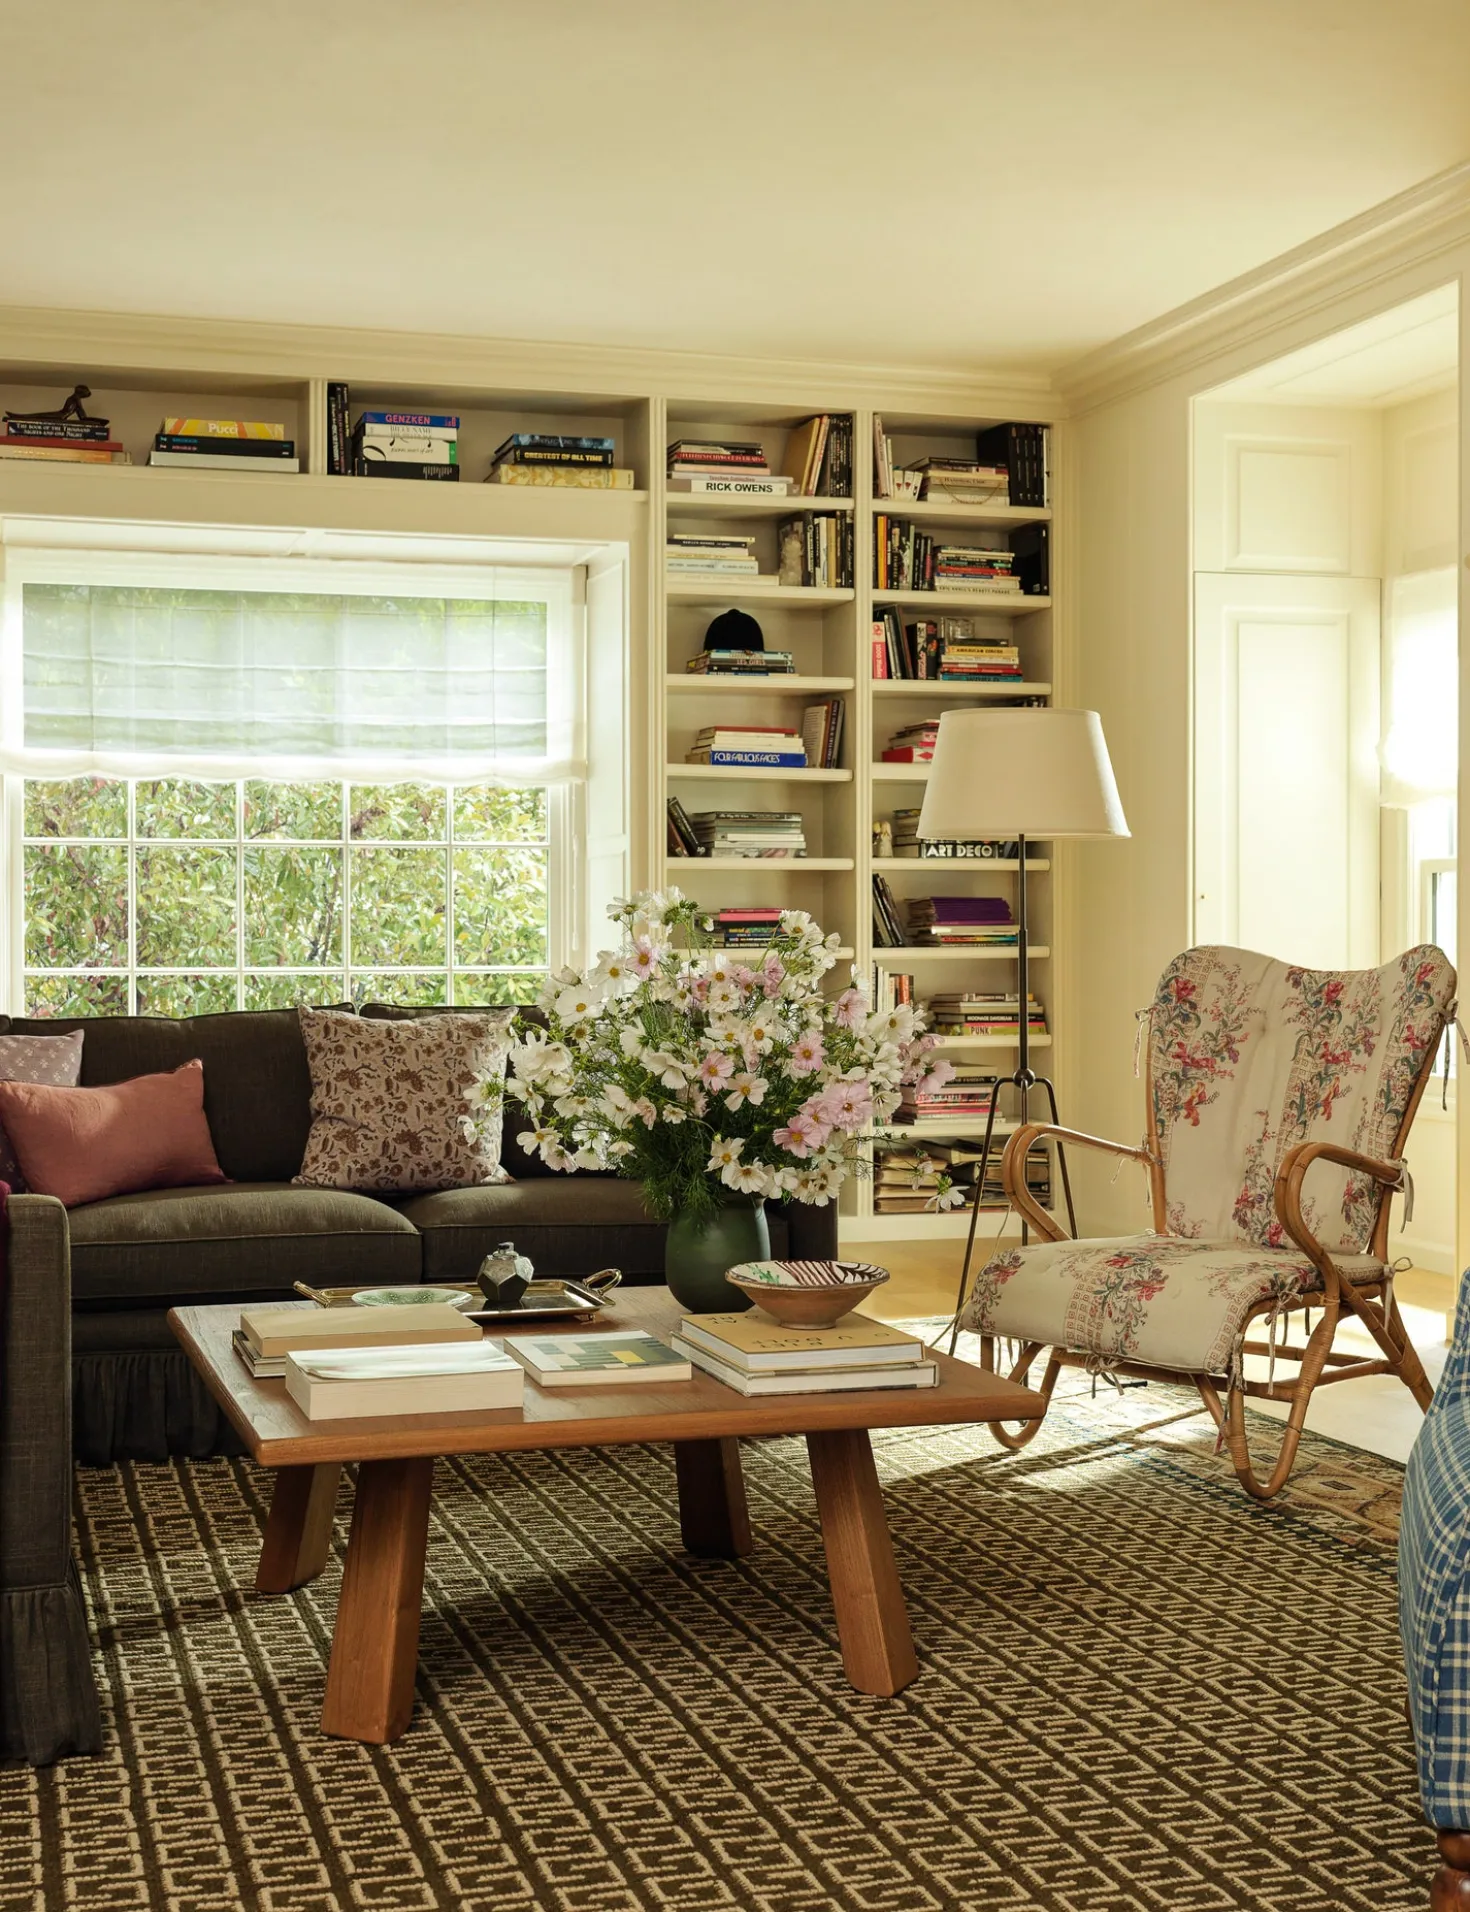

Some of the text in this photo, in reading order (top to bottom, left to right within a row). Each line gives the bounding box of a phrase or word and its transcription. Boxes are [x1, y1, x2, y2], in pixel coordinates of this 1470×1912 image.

[385, 413, 431, 424] GENZKEN
[208, 422, 238, 434] Pucci
[524, 452, 560, 460] GREATEST
[585, 454, 603, 462] TIME
[706, 482, 773, 493] RICK OWENS
[714, 752, 780, 763] FOUR FABULOUS FACES
[926, 844, 992, 856] ART DECO
[970, 1026, 990, 1035] PUNK
